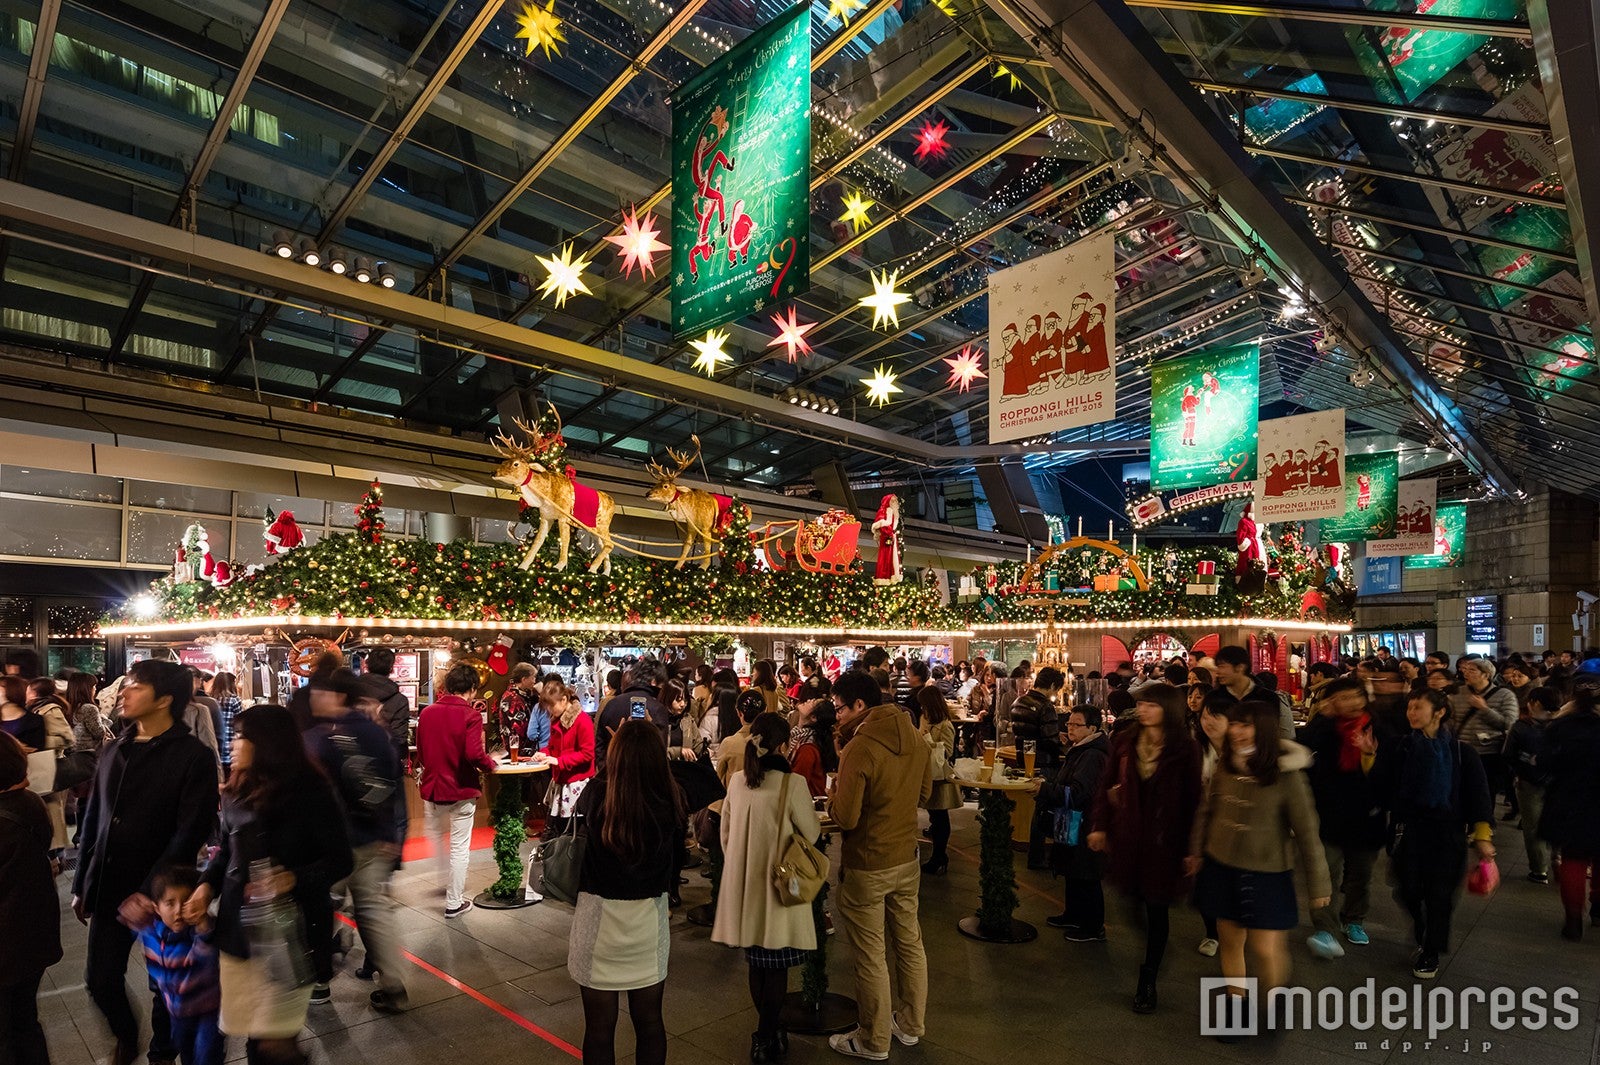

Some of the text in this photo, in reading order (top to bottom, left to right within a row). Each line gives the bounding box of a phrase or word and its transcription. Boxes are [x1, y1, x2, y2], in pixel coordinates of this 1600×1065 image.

[746, 270, 773, 287] PURCHASE
[1000, 391, 1103, 421] ROPPONGI HILLS
[1000, 401, 1103, 429] CHRISTMAS MARKET 2015
[1171, 484, 1239, 507] CHRISTMAS
[1243, 481, 1254, 492] M
[1262, 499, 1337, 512] ROPPONGI HILLS
